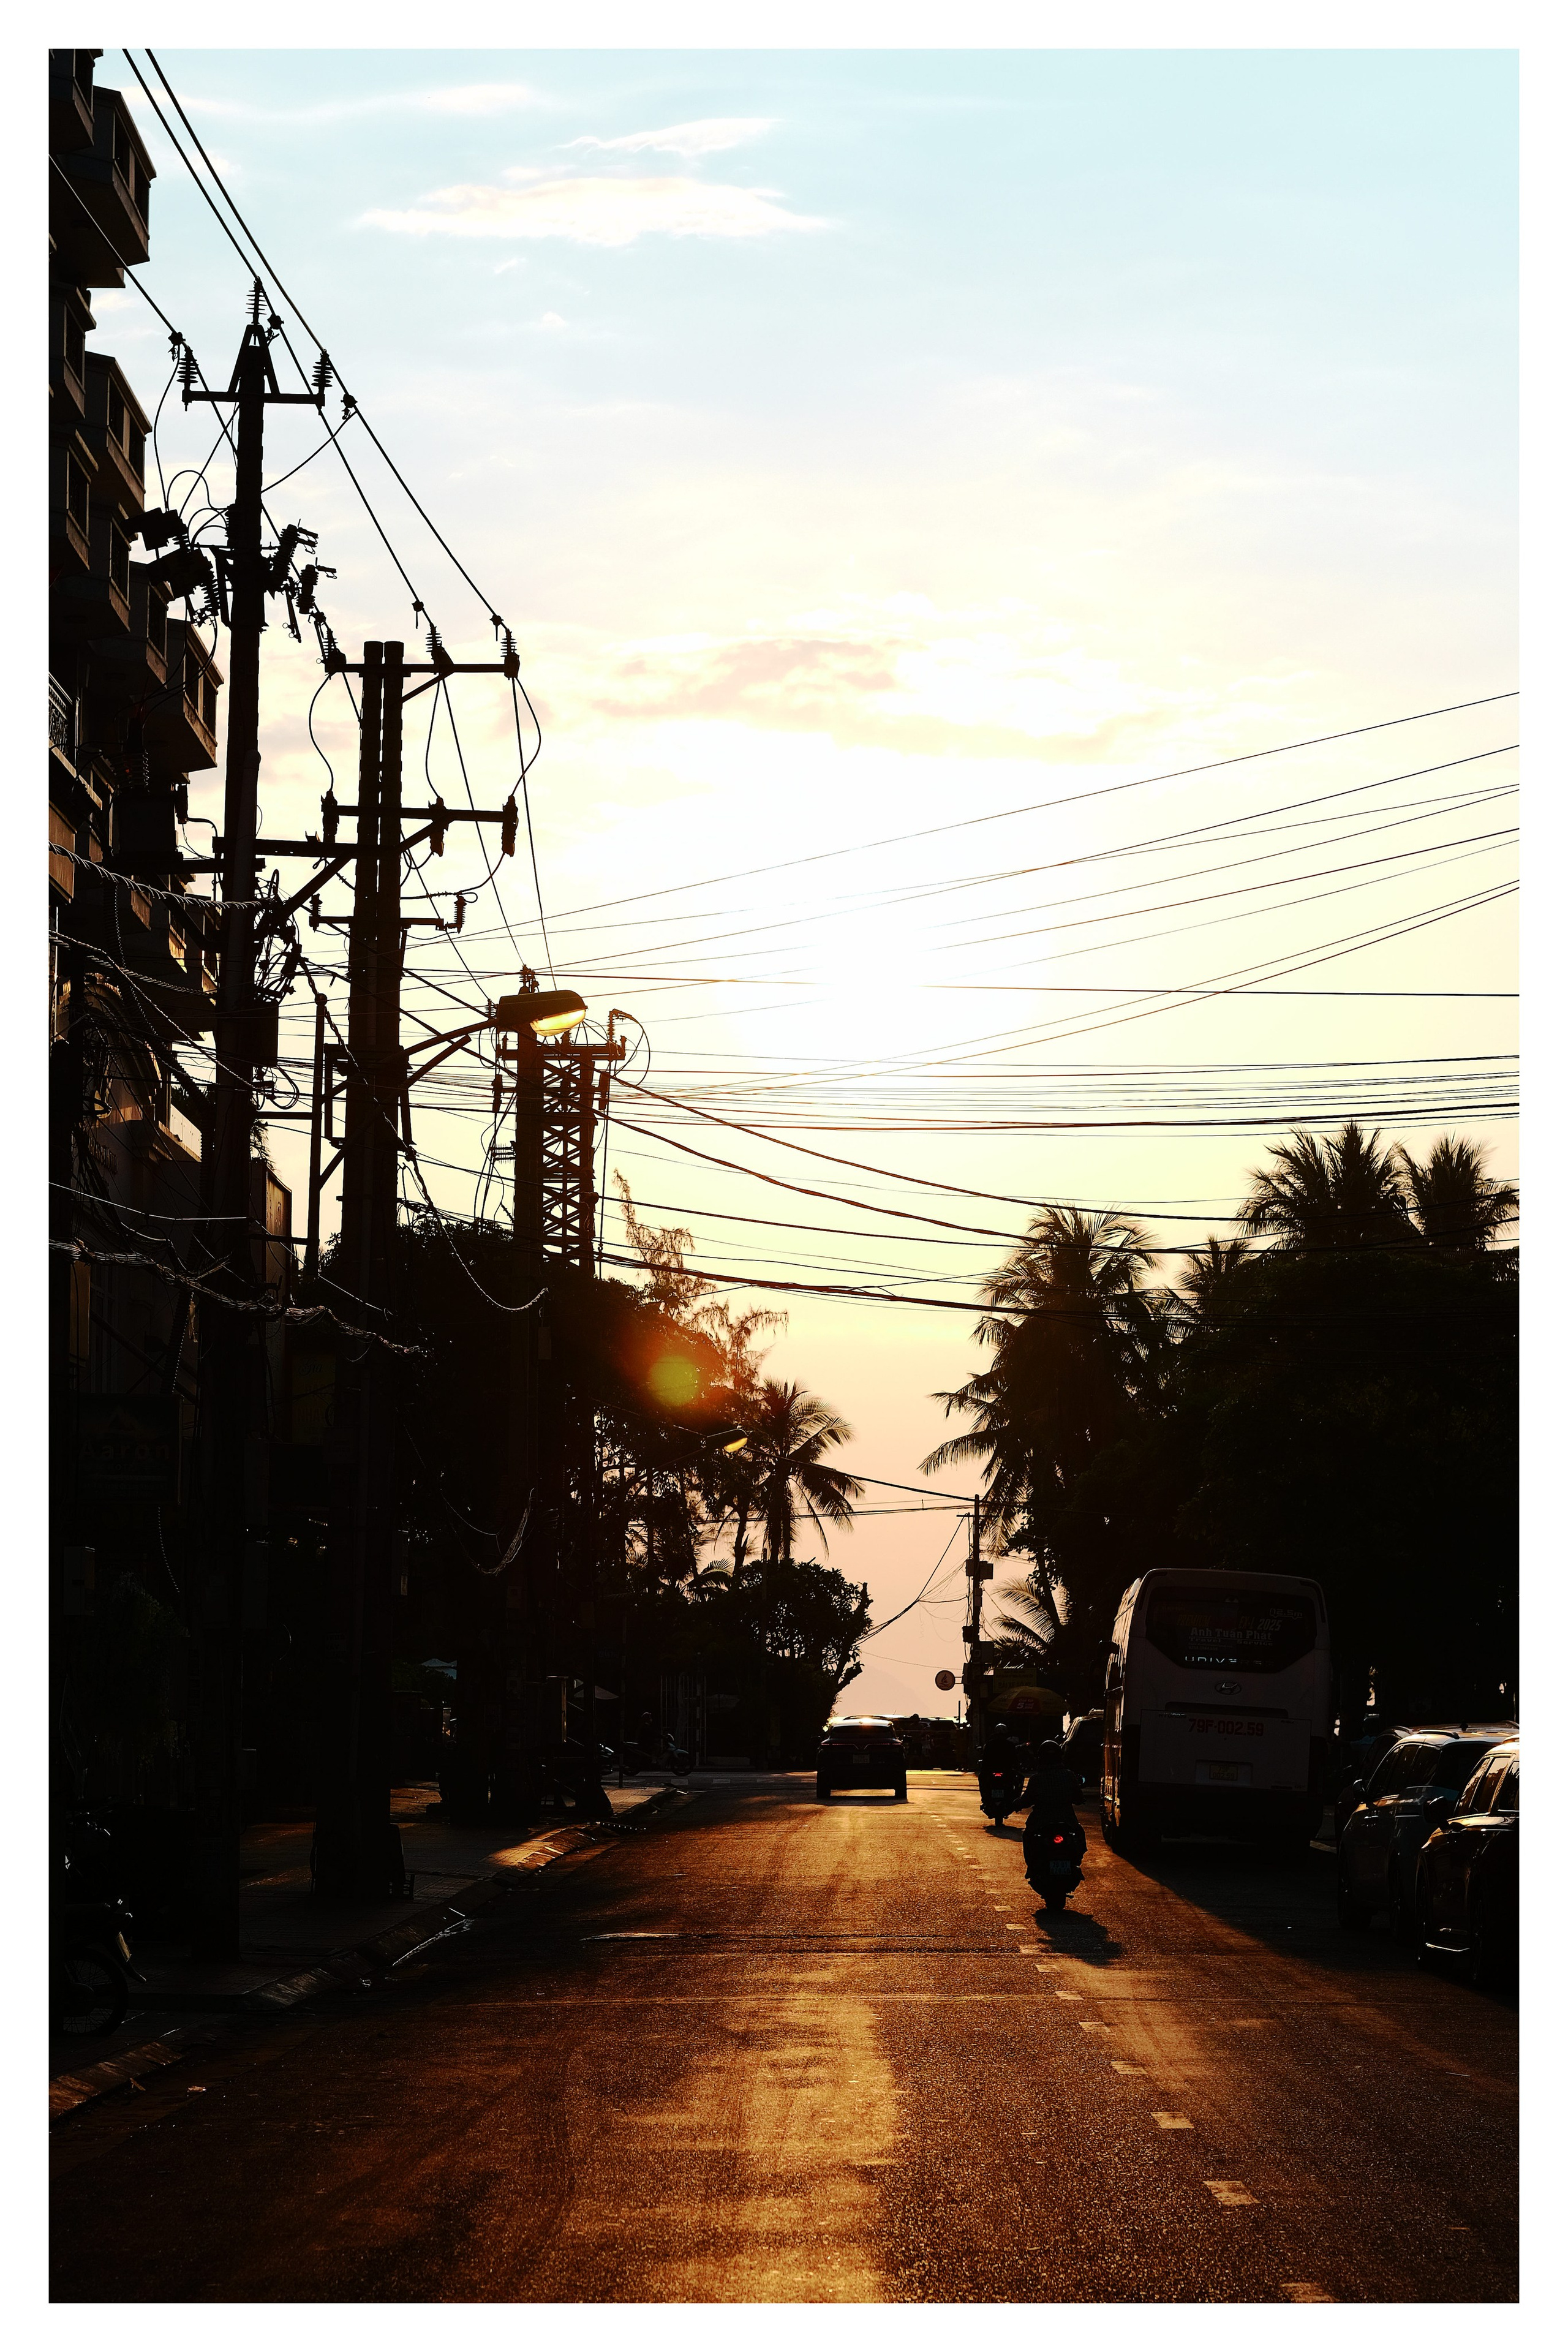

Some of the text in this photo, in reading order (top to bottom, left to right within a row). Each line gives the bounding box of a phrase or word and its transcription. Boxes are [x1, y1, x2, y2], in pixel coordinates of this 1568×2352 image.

[78, 1439, 170, 1461] Aaron
[1190, 1627, 1213, 1637] Anh
[1257, 1618, 1283, 1632] 2025
